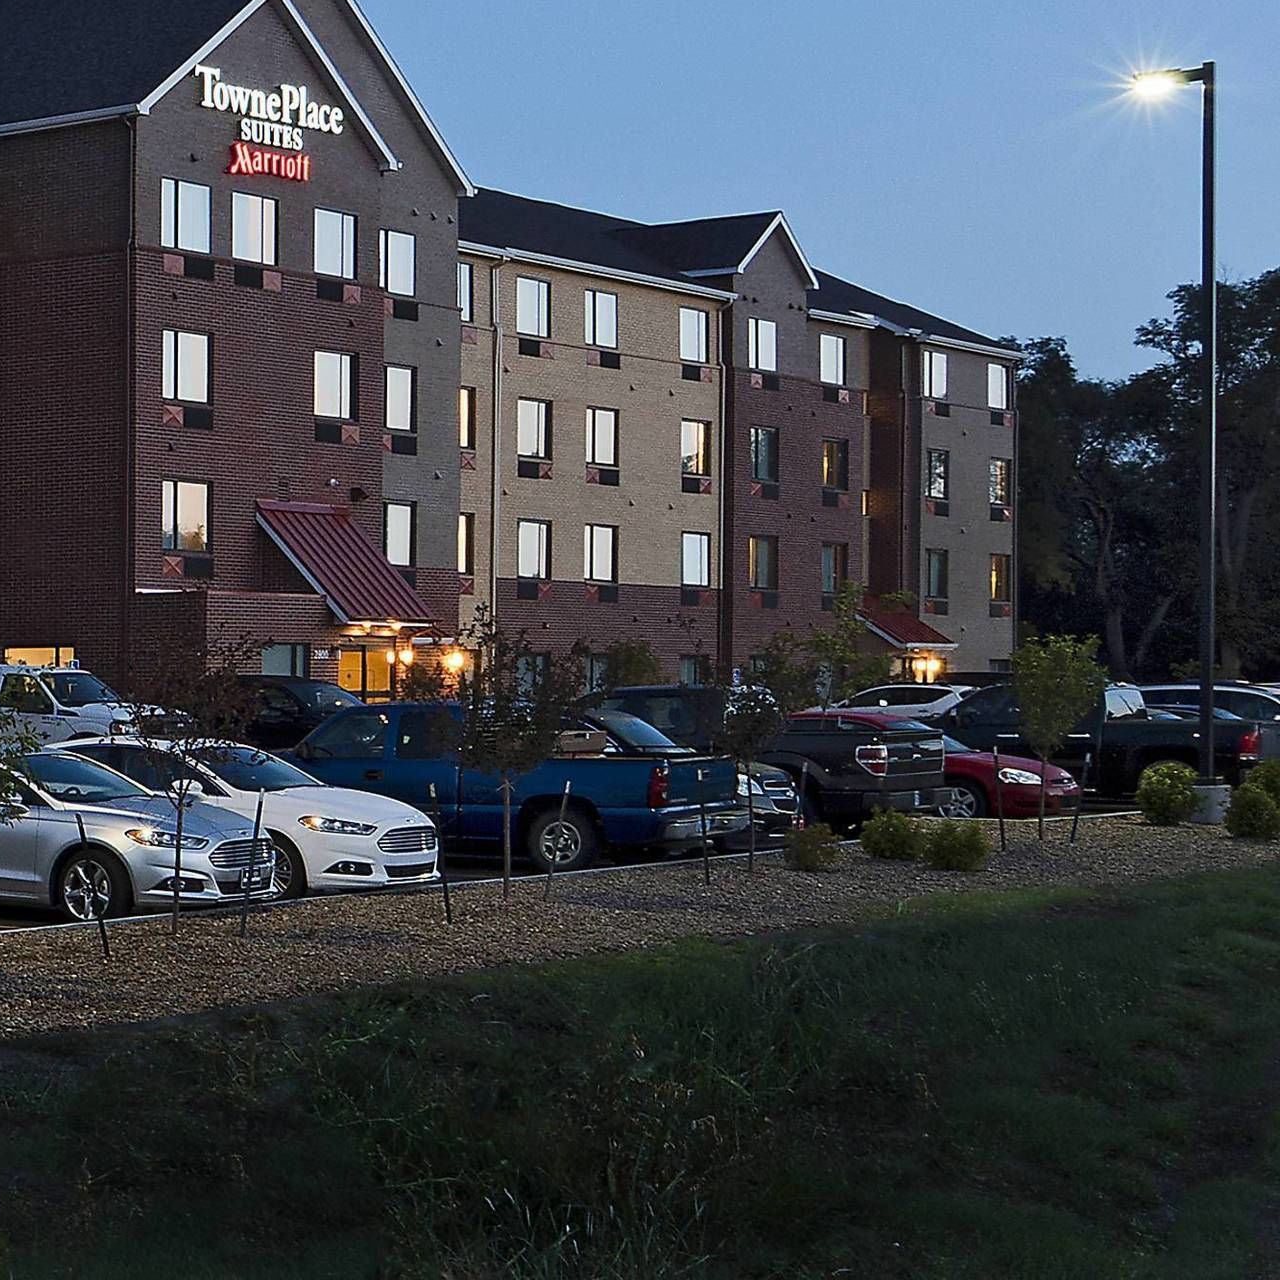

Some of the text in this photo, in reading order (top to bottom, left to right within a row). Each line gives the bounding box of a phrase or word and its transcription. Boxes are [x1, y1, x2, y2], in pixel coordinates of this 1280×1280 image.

[195, 64, 344, 135] TownePlace
[240, 118, 304, 151] SUITES
[228, 142, 310, 182] Marriott
